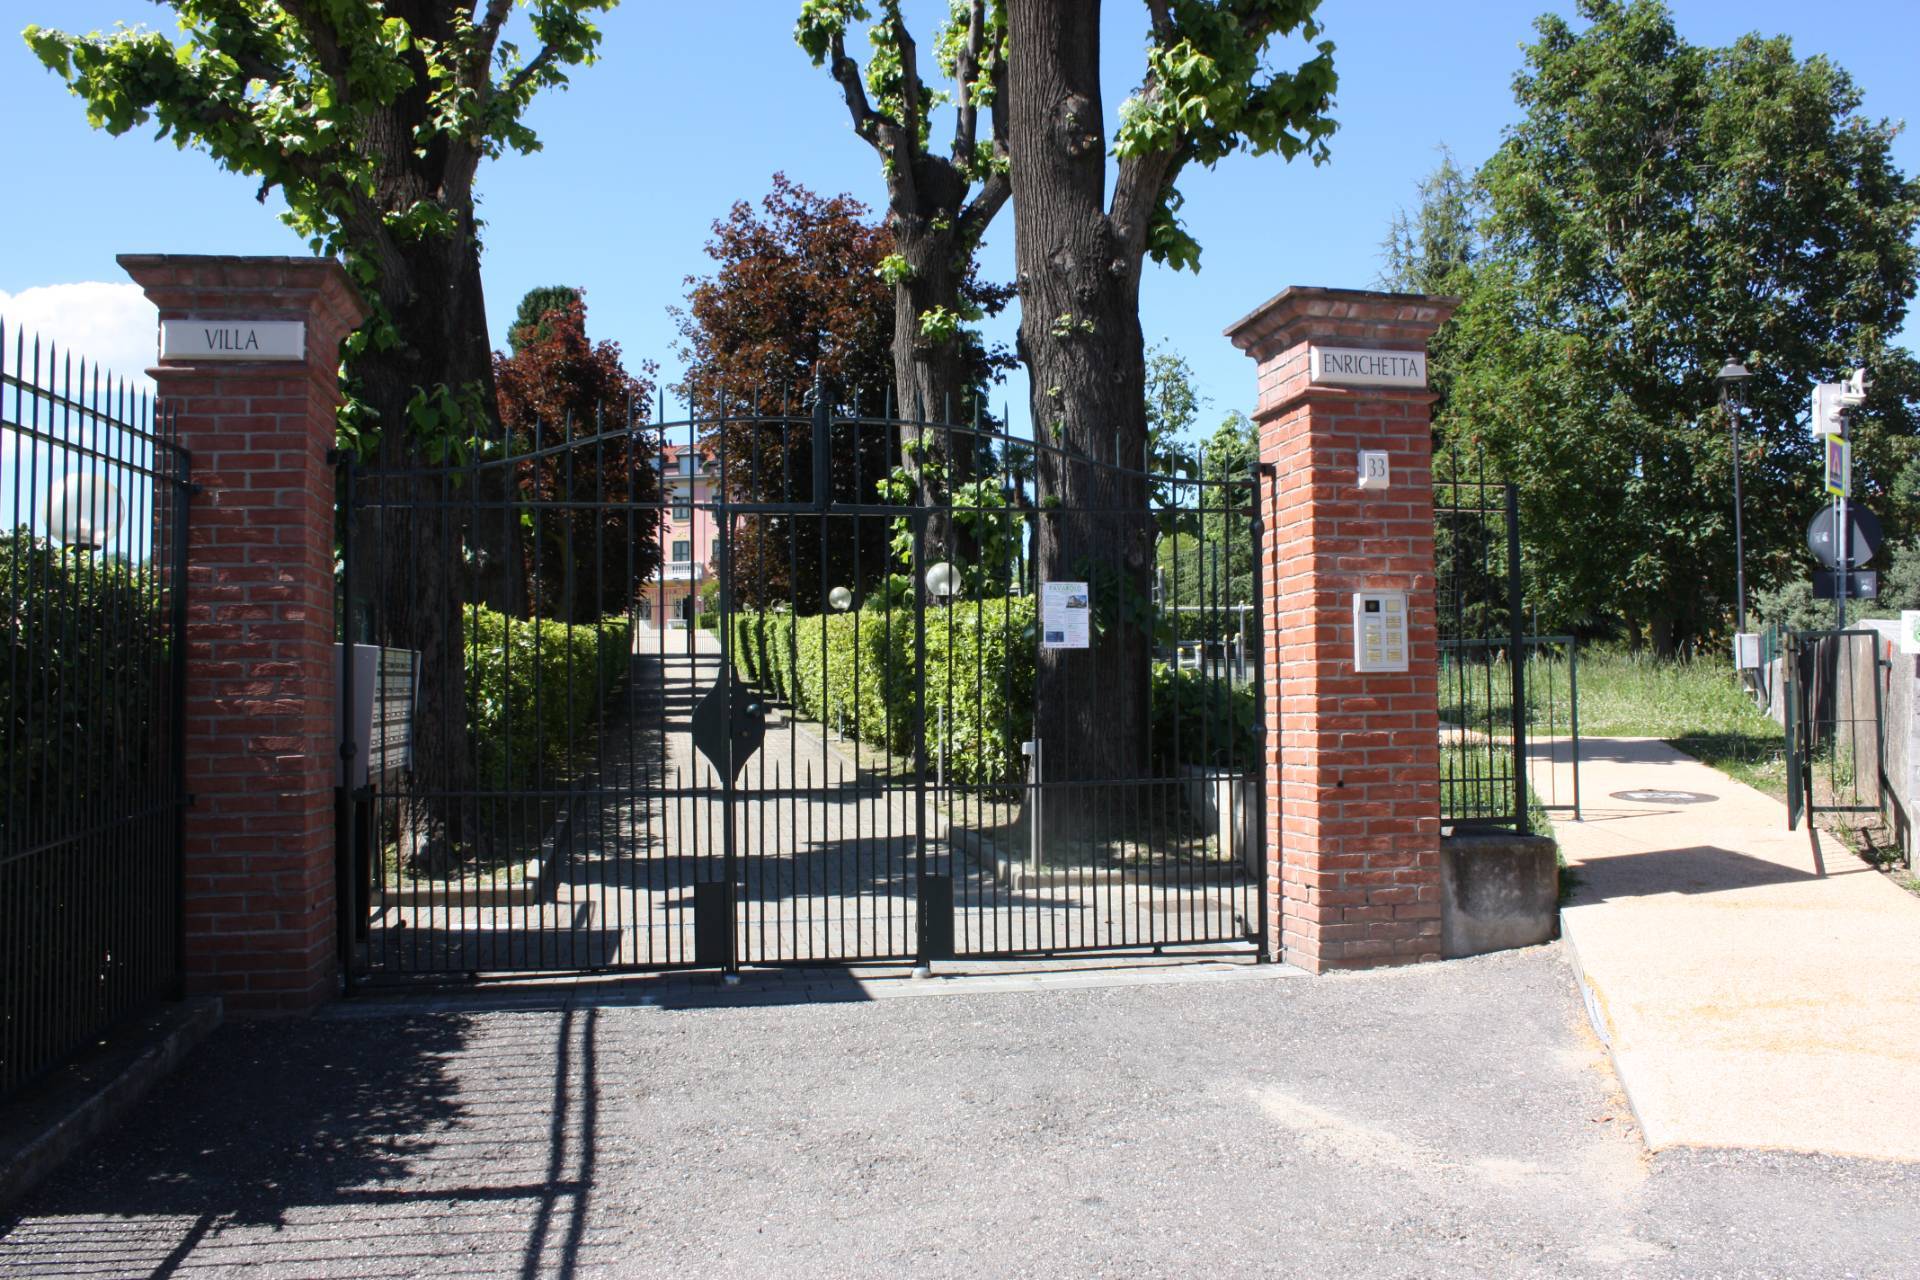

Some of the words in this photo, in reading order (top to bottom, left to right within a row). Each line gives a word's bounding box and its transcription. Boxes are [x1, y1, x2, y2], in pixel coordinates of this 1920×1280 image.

[205, 328, 259, 350] VILLA
[1323, 353, 1419, 377] ENRICHETTA
[1368, 458, 1385, 477] 33
